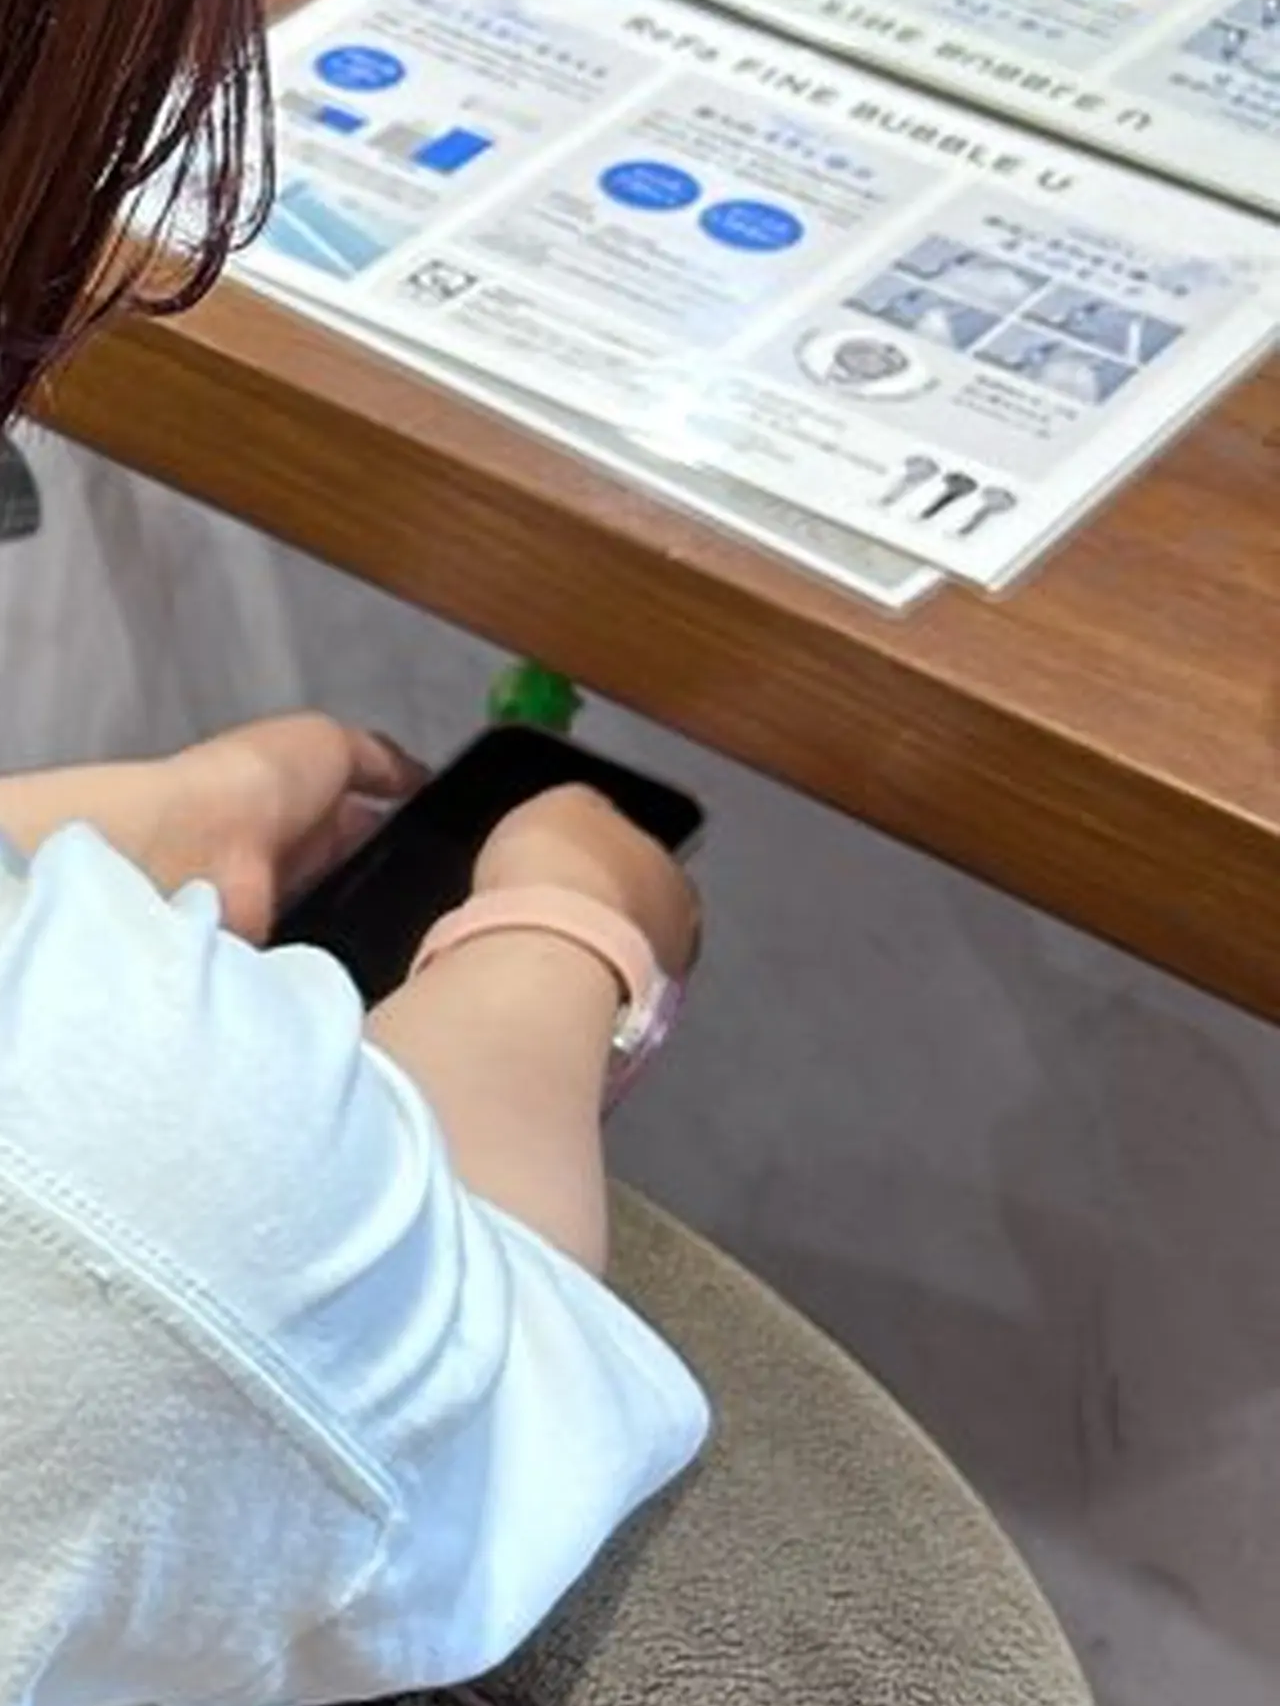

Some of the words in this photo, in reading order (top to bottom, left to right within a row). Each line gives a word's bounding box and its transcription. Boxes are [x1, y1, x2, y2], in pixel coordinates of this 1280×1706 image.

[731, 55, 839, 106] FINE
[848, 98, 1025, 176] BUBBLE
[1037, 168, 1074, 193] U
